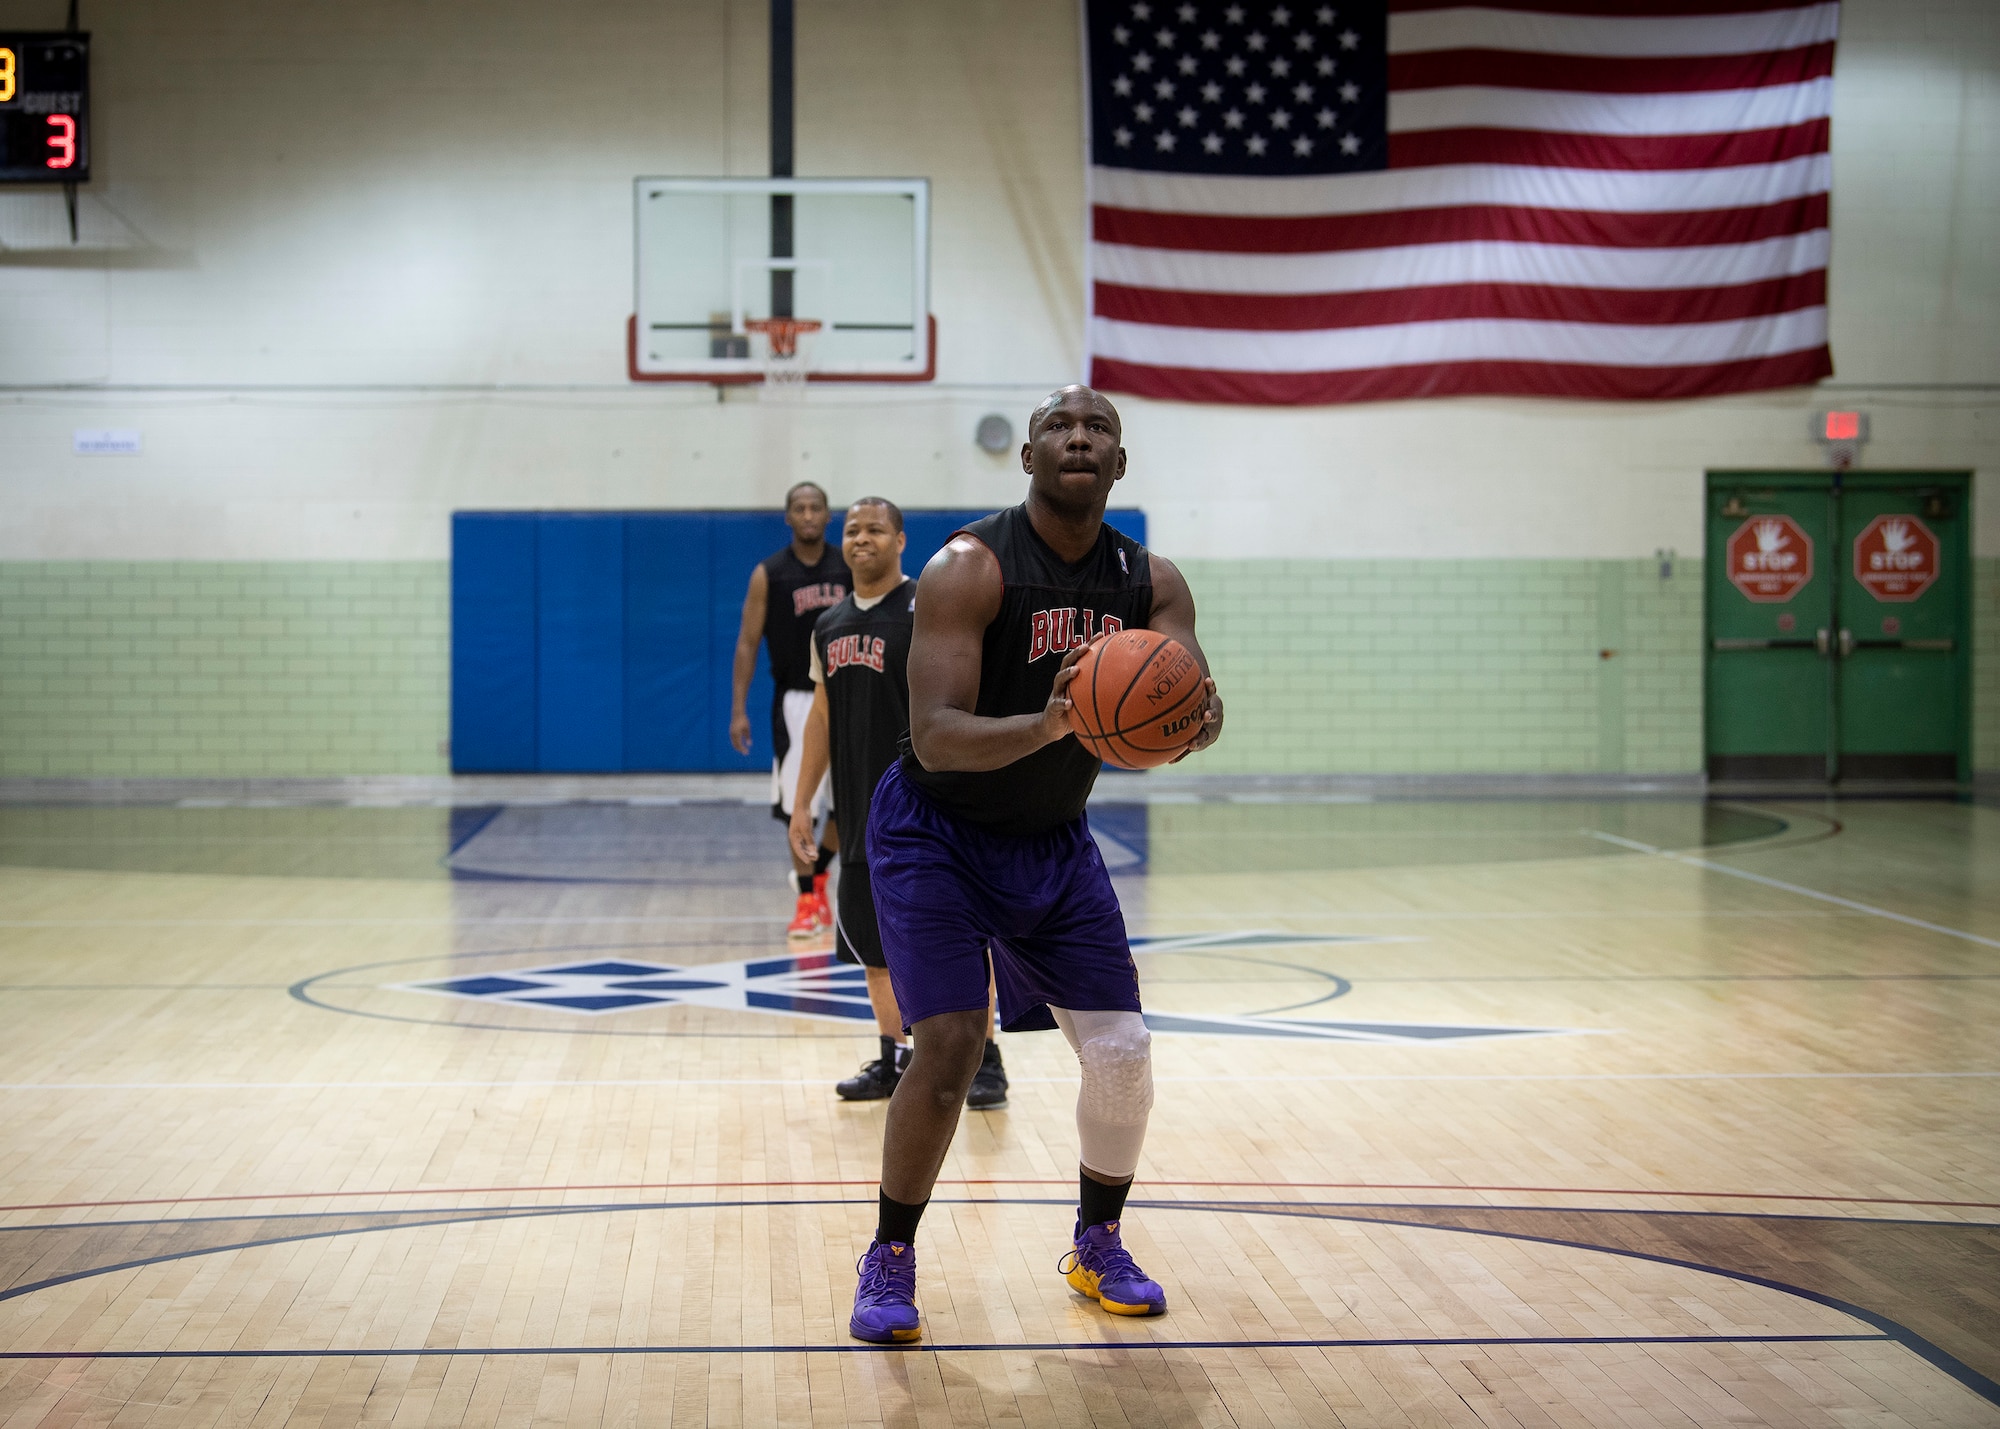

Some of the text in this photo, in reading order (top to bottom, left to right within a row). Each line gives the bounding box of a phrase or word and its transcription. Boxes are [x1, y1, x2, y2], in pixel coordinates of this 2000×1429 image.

[46, 113, 76, 169] 3
[1743, 552, 1797, 570] STOP
[1870, 552, 1923, 570] STOP
[827, 634, 885, 677] BULLS
